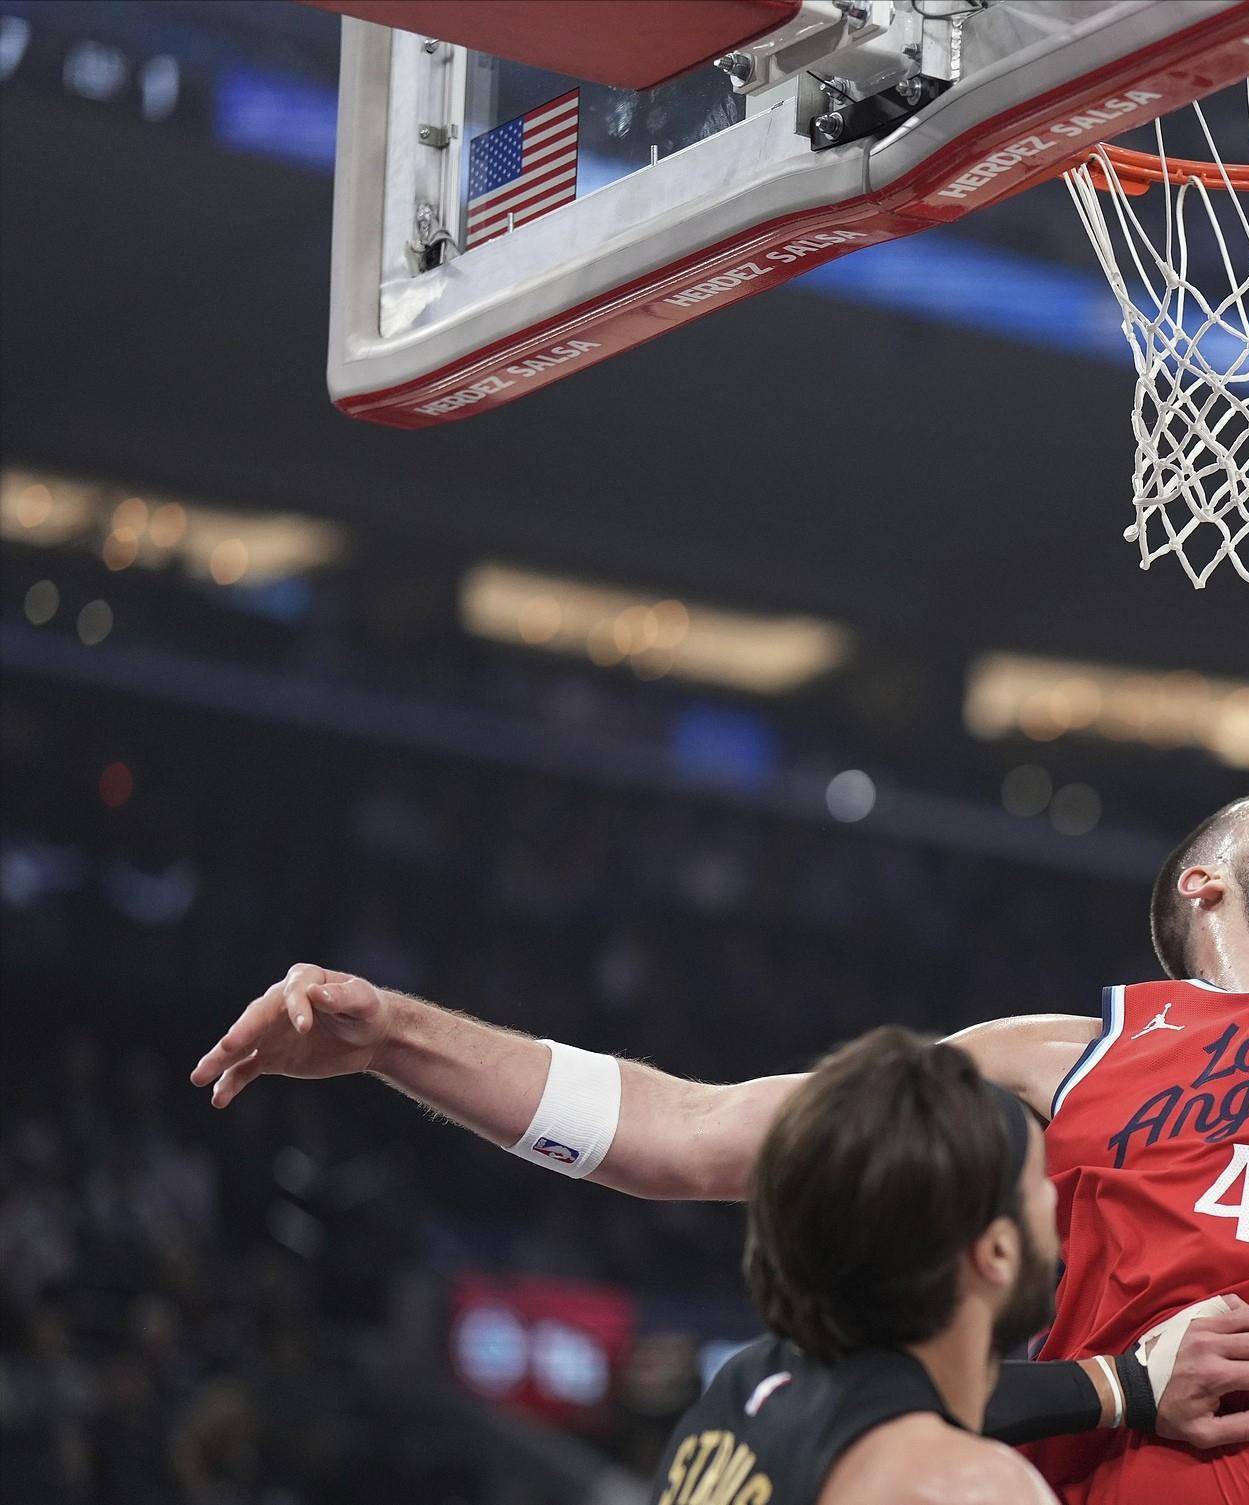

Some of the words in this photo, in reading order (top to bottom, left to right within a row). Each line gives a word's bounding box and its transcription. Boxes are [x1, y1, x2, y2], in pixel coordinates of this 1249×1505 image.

[937, 135, 1057, 199] HERDEZ
[1051, 90, 1164, 138] SALSA
[663, 262, 774, 307] HERDEZ
[766, 230, 868, 264] SALSA
[413, 375, 516, 416] HERDEZ
[506, 339, 602, 378] SALSA
